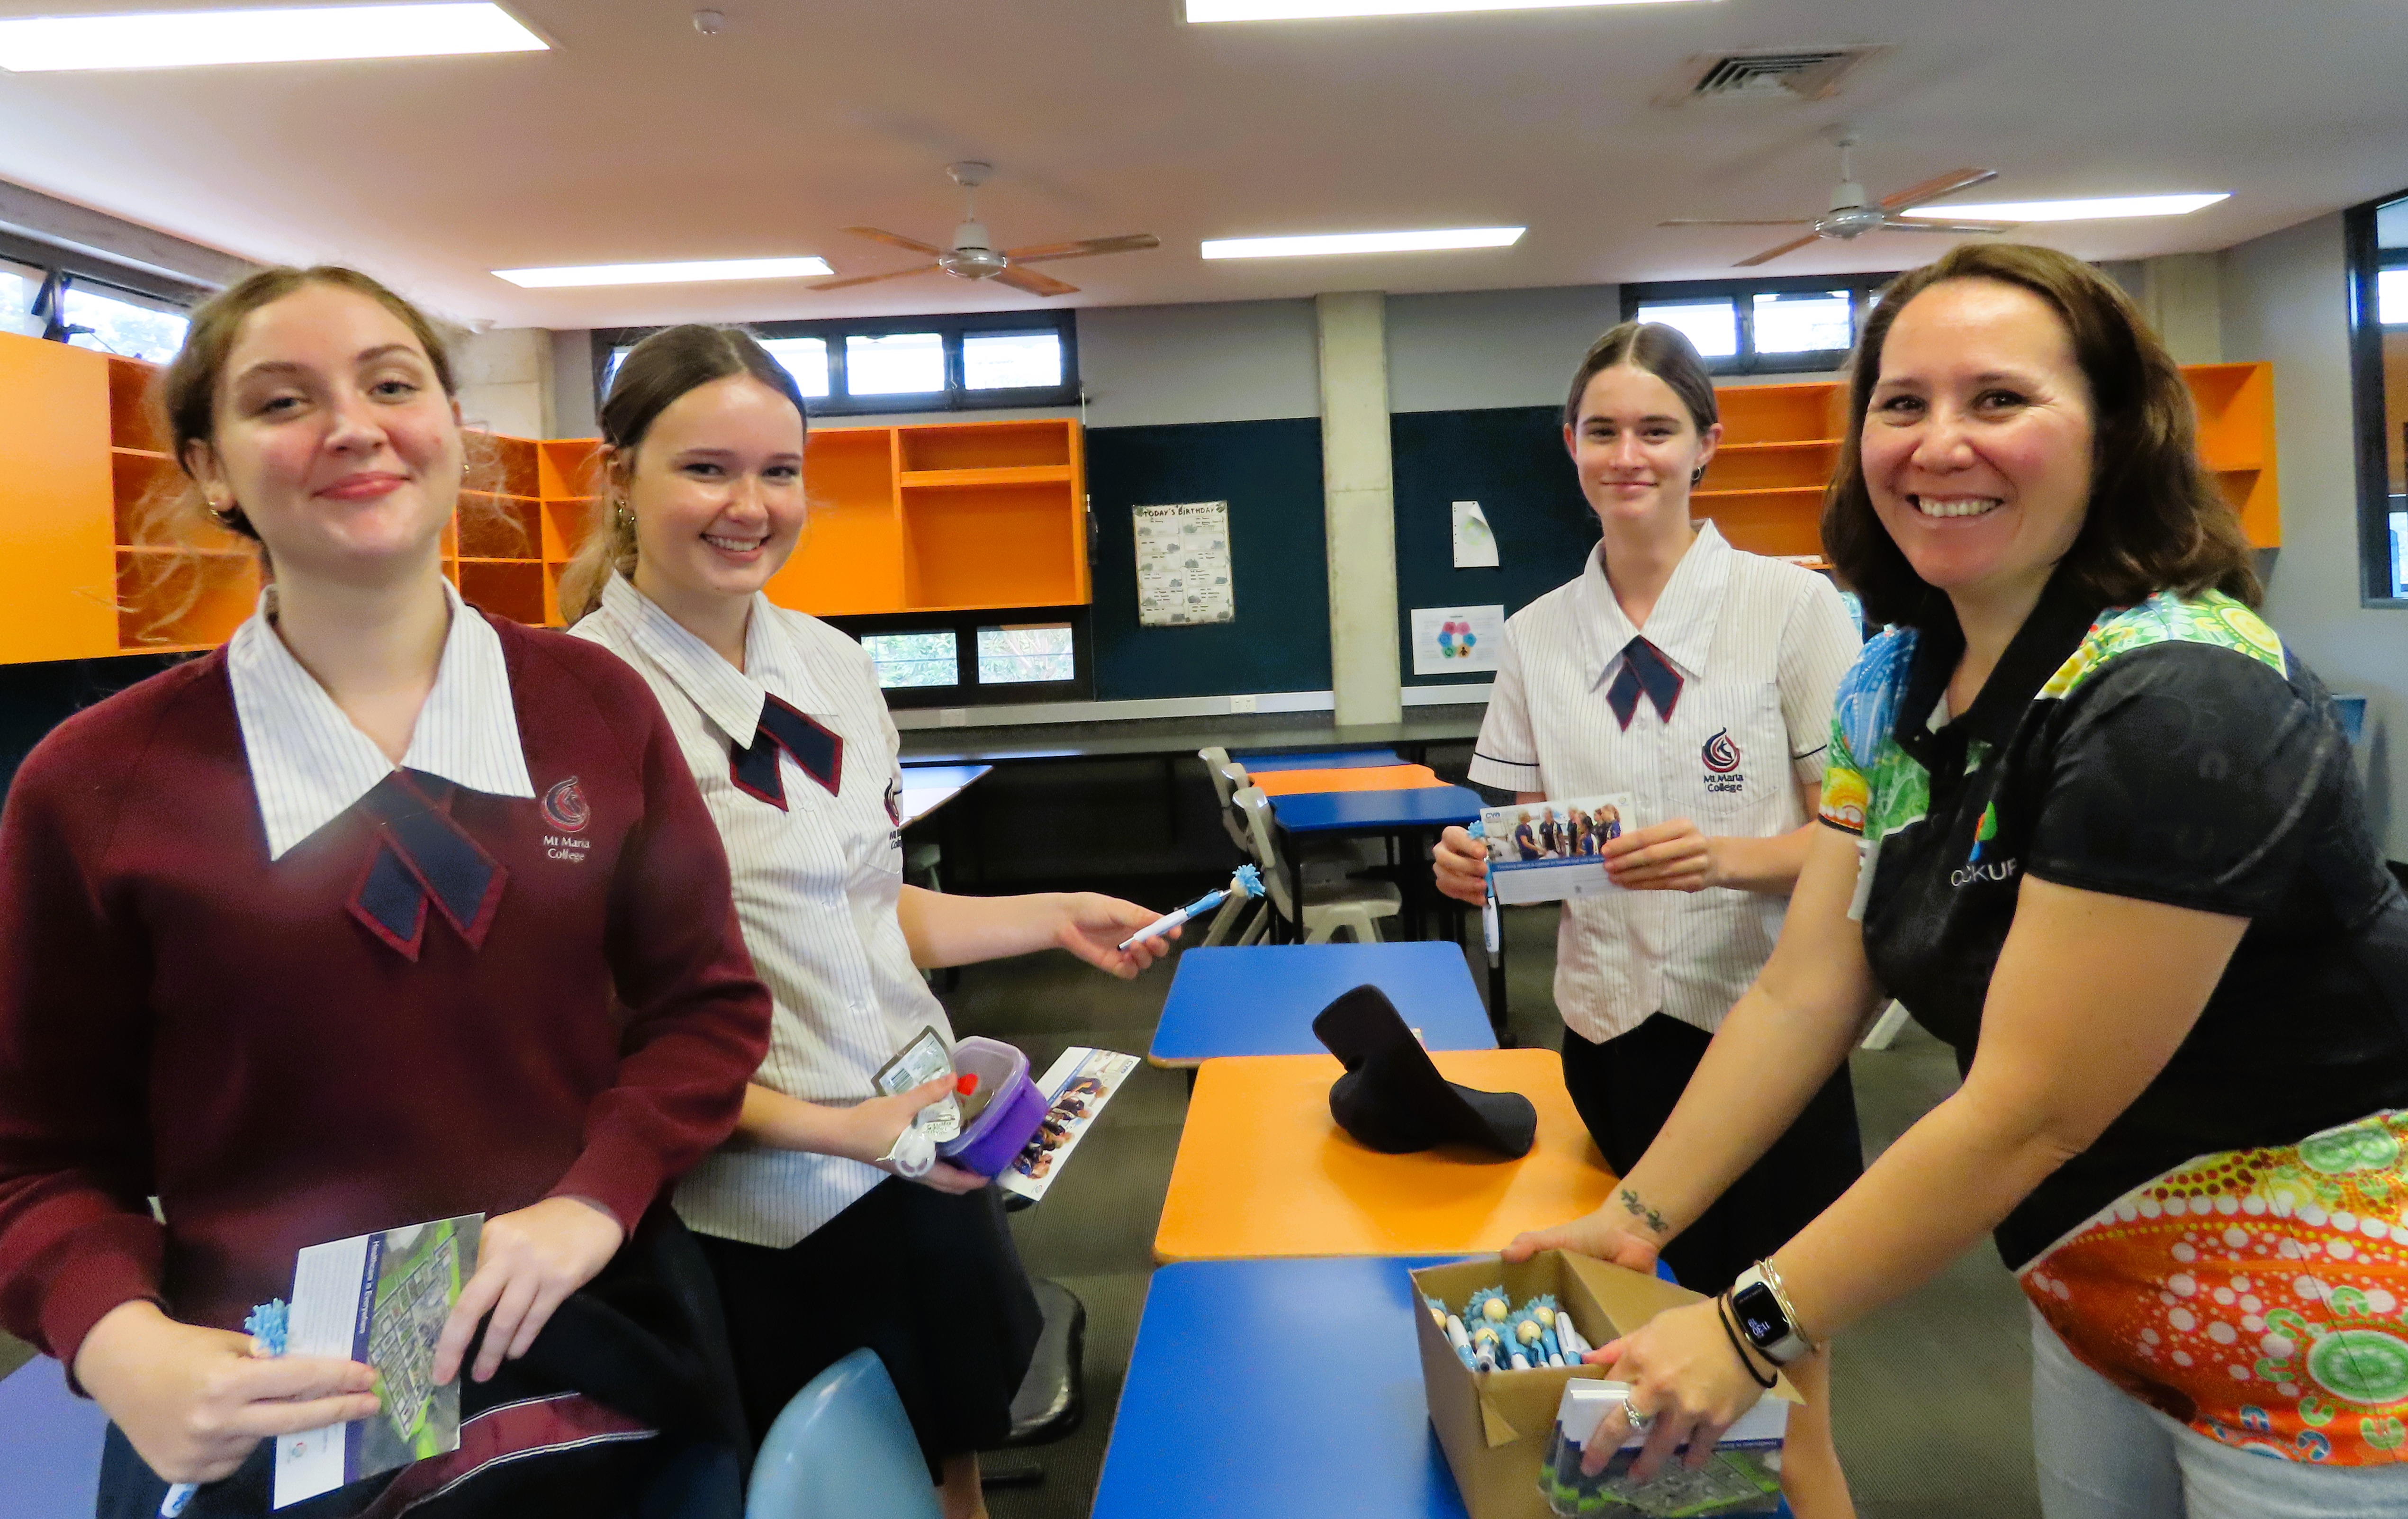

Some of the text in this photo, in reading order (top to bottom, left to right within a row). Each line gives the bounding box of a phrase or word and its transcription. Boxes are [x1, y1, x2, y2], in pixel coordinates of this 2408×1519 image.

[1144, 508, 1175, 516] TODAY'S
[1718, 774, 1744, 782] Maria
[1708, 783, 1742, 793] College
[543, 835, 590, 848] Mt Maria
[548, 848, 585, 862] College
